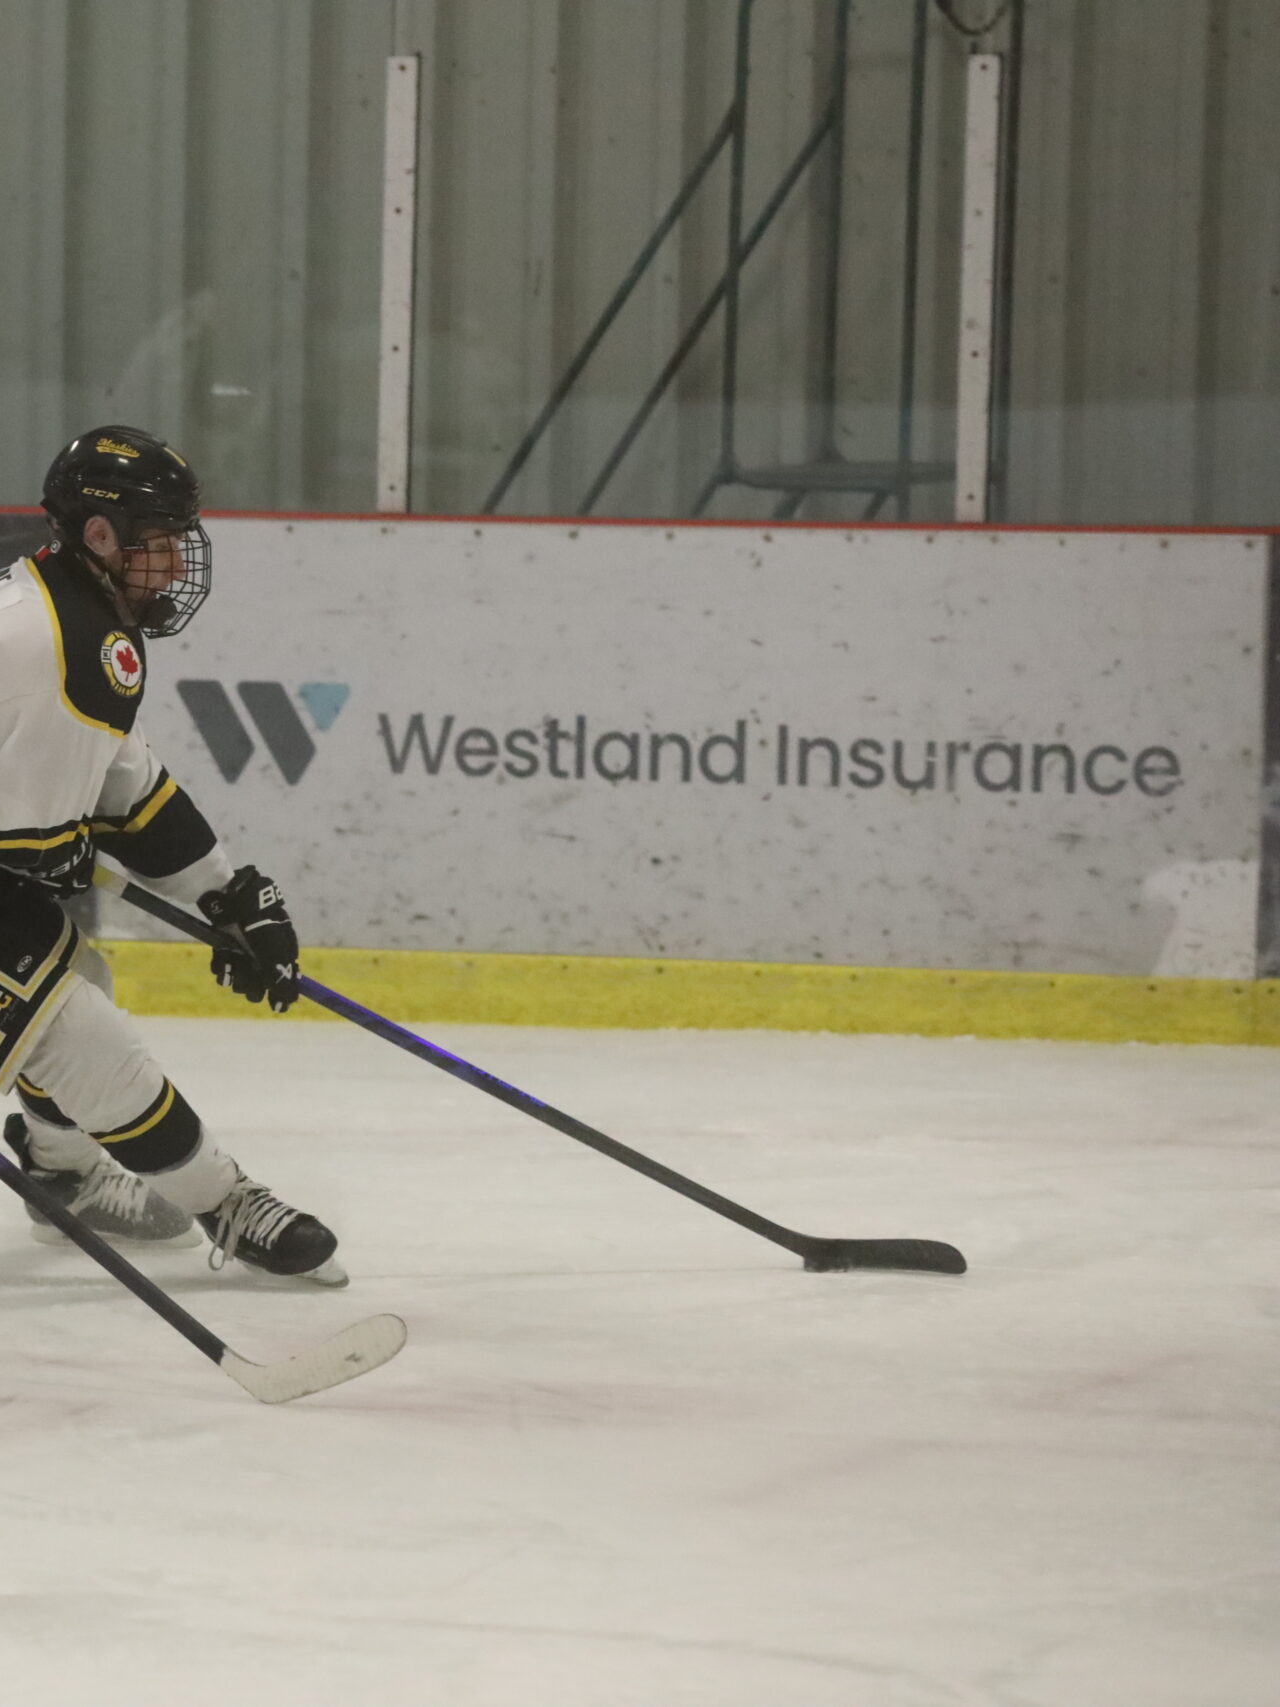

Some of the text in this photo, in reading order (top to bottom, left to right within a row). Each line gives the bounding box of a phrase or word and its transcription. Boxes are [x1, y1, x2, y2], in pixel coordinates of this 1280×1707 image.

[81, 487, 120, 500] CCM
[377, 712, 1182, 798] Westland Insurance
